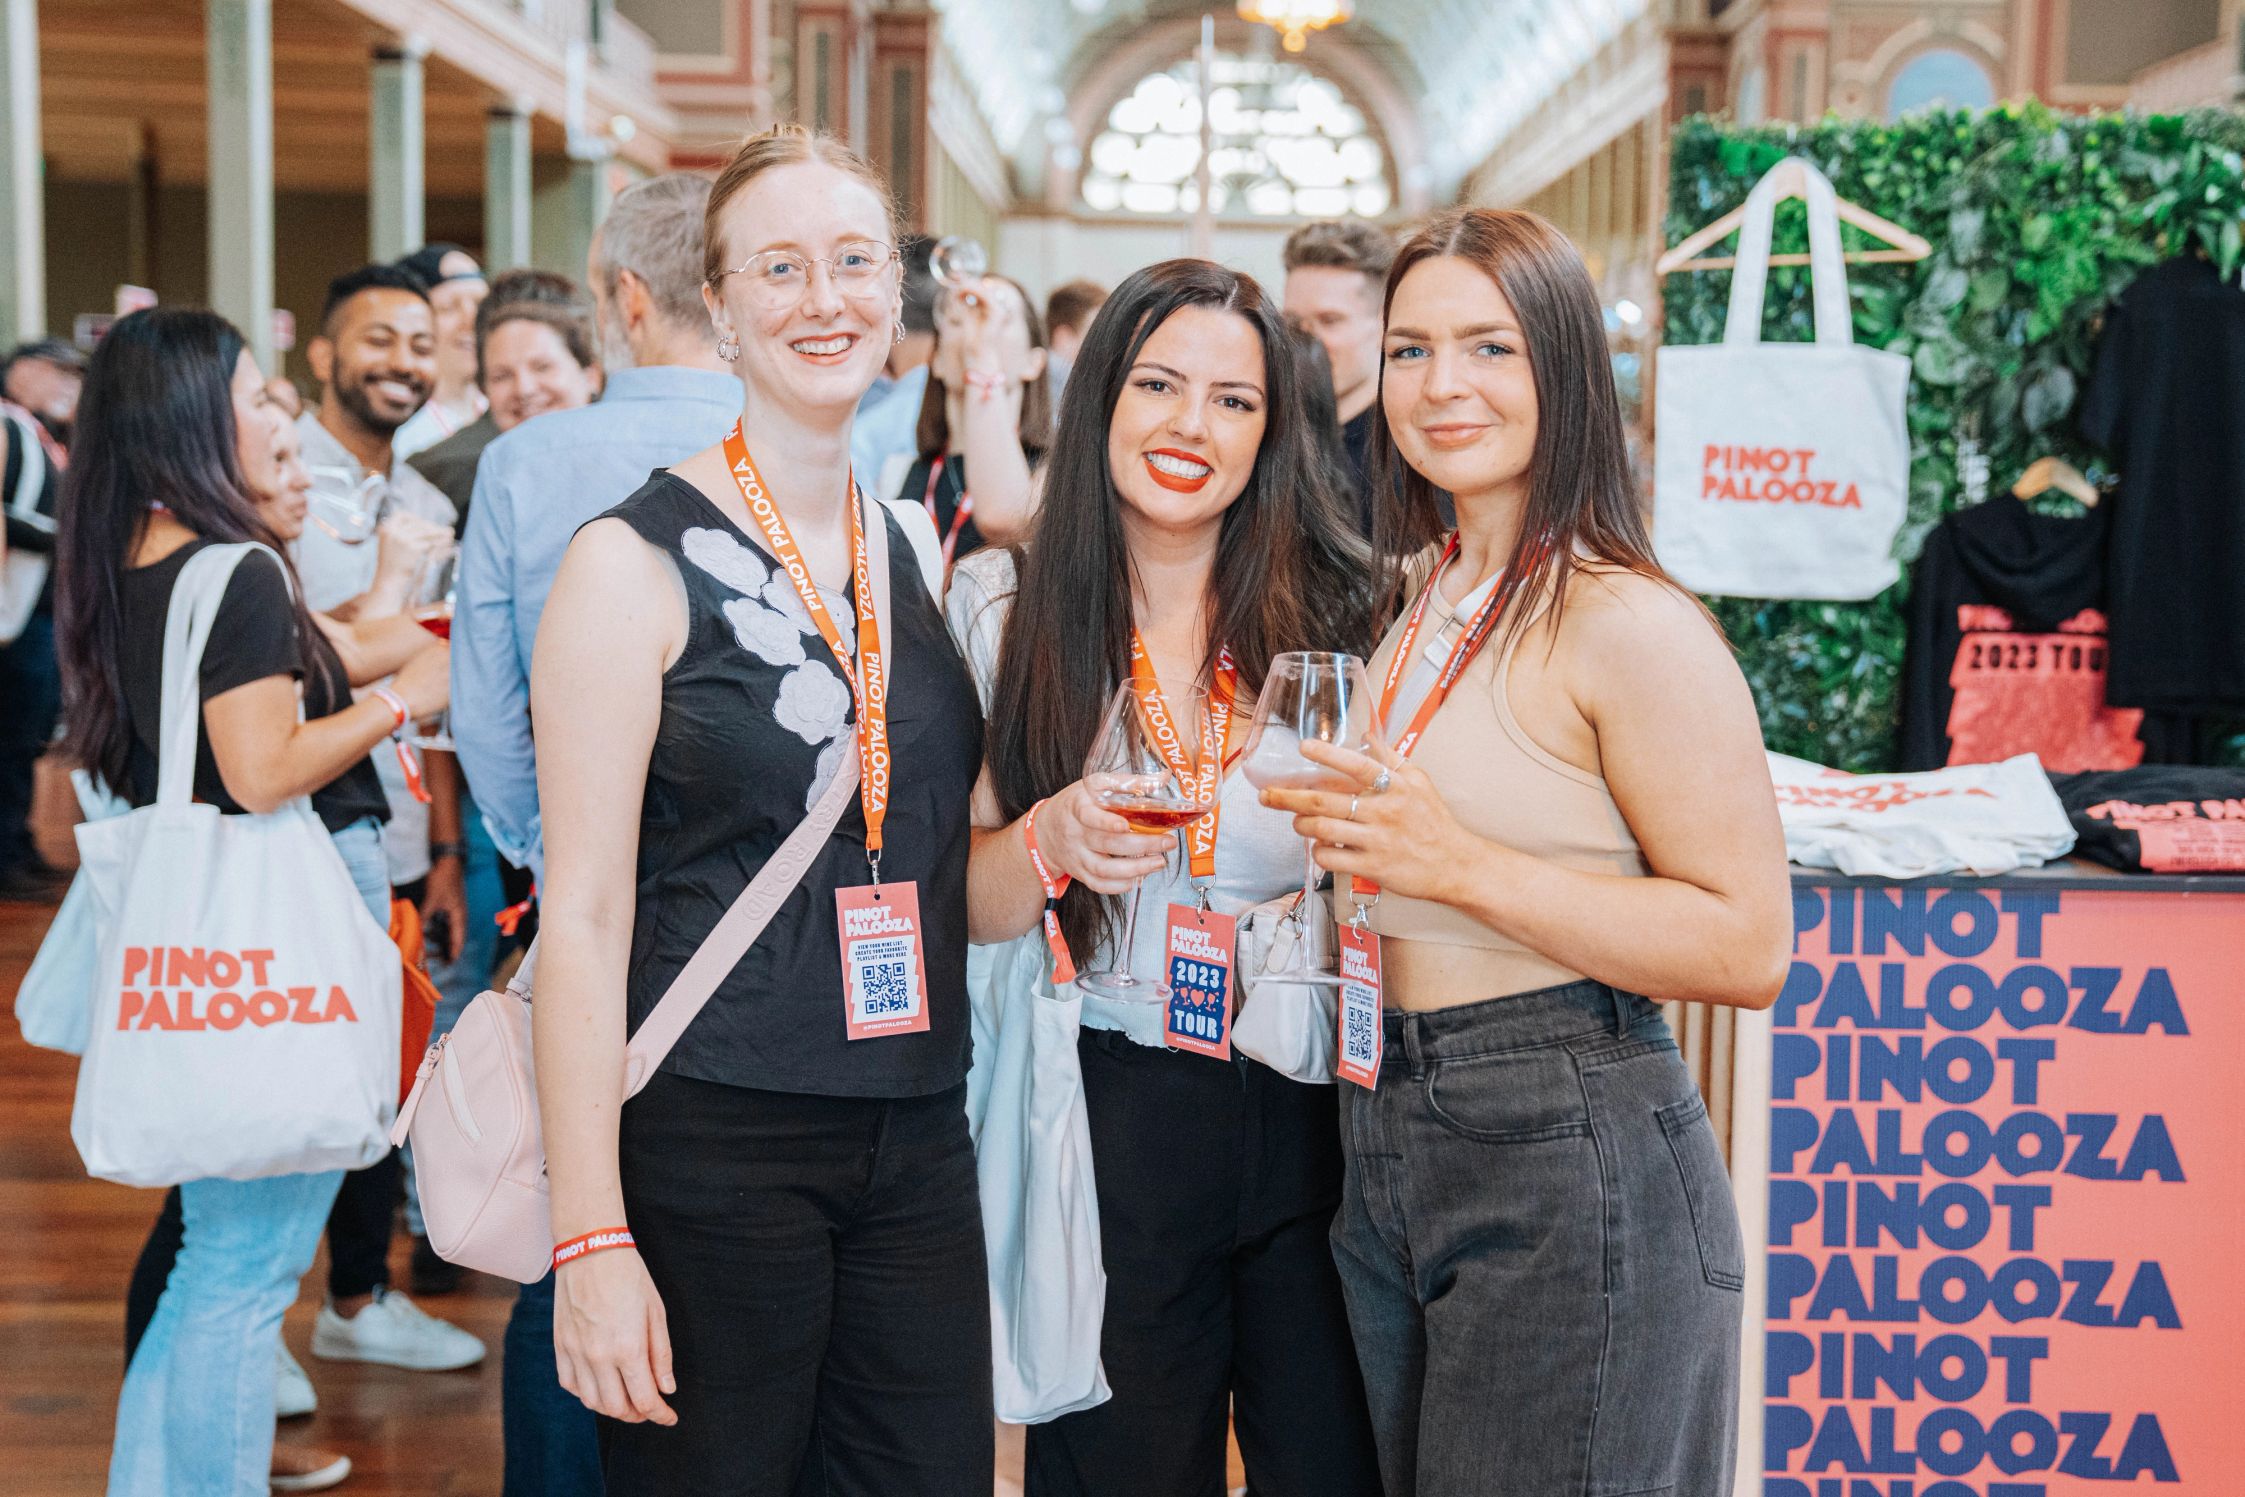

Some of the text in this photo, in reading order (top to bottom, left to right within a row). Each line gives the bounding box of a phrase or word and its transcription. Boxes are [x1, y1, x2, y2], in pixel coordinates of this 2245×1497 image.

[1703, 445, 1816, 475] PINOT
[1702, 473, 1862, 509] PALOOZA
[733, 457, 824, 612] PINOT PALOOZA
[856, 535, 875, 621] PALOOZA
[1971, 644, 2104, 671] 2023 TOU
[864, 652, 888, 813] PINOT PALOOZA
[1030, 848, 1052, 883] PINOT
[844, 906, 891, 923] PINOT
[845, 917, 914, 937] PALOOZA
[1793, 887, 2062, 958] PINOT
[1170, 939, 1228, 963] PALOOZA
[1171, 925, 1211, 944] PINOT
[122, 946, 275, 987] PINOT
[1176, 960, 1221, 989] 2023
[1342, 958, 1378, 984] PALOOZA
[1343, 946, 1368, 965] PINOT
[116, 985, 359, 1031] PALOOZA
[1774, 961, 2190, 1036] PALOOZA
[1174, 1009, 1218, 1040] TOUR
[1771, 1033, 2056, 1105] PINOT
[1769, 1107, 2187, 1183] PALOOZA
[1768, 1180, 2052, 1251] PINOT
[555, 1240, 586, 1263] PINOT
[1767, 1253, 2183, 1330] PALOOZA
[1765, 1331, 2049, 1403] PINOT
[1763, 1404, 2181, 1482] PALOOZA
